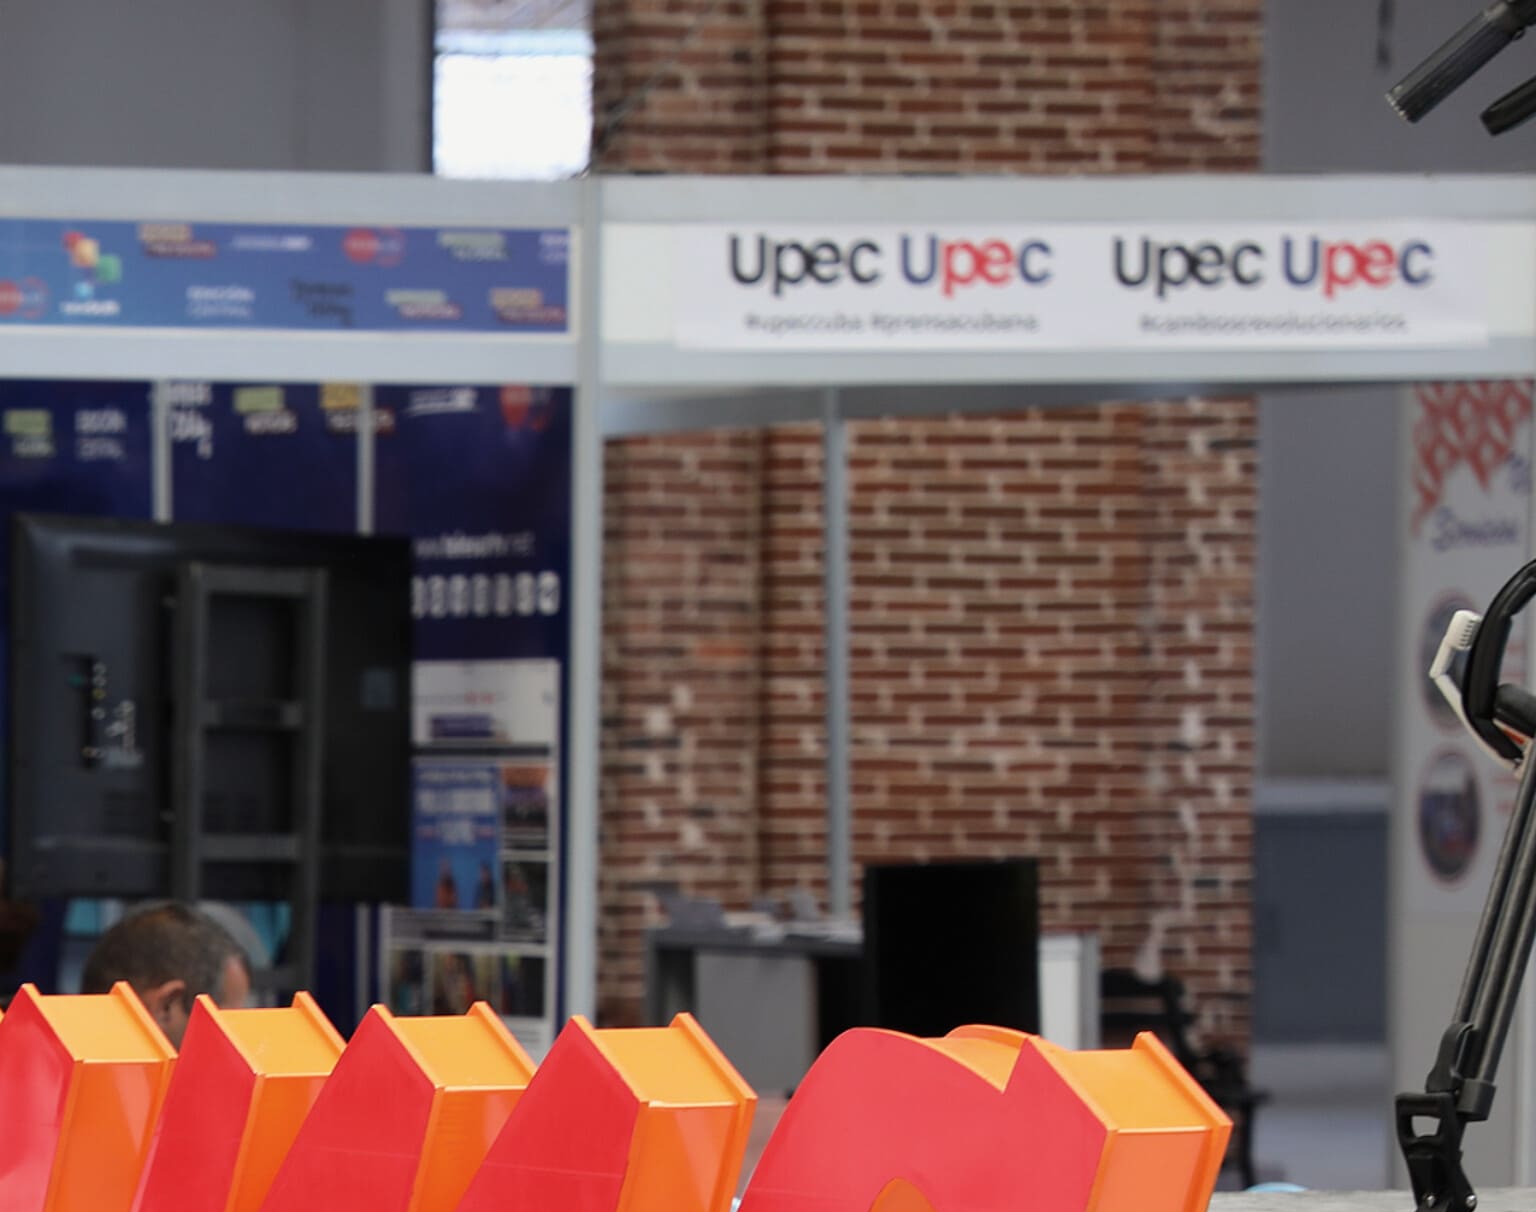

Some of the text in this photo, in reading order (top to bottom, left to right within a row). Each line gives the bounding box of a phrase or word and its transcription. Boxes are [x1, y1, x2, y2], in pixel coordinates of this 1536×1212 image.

[729, 233, 1052, 298] Upec Upec
[1113, 235, 1435, 300] Upec Upec
